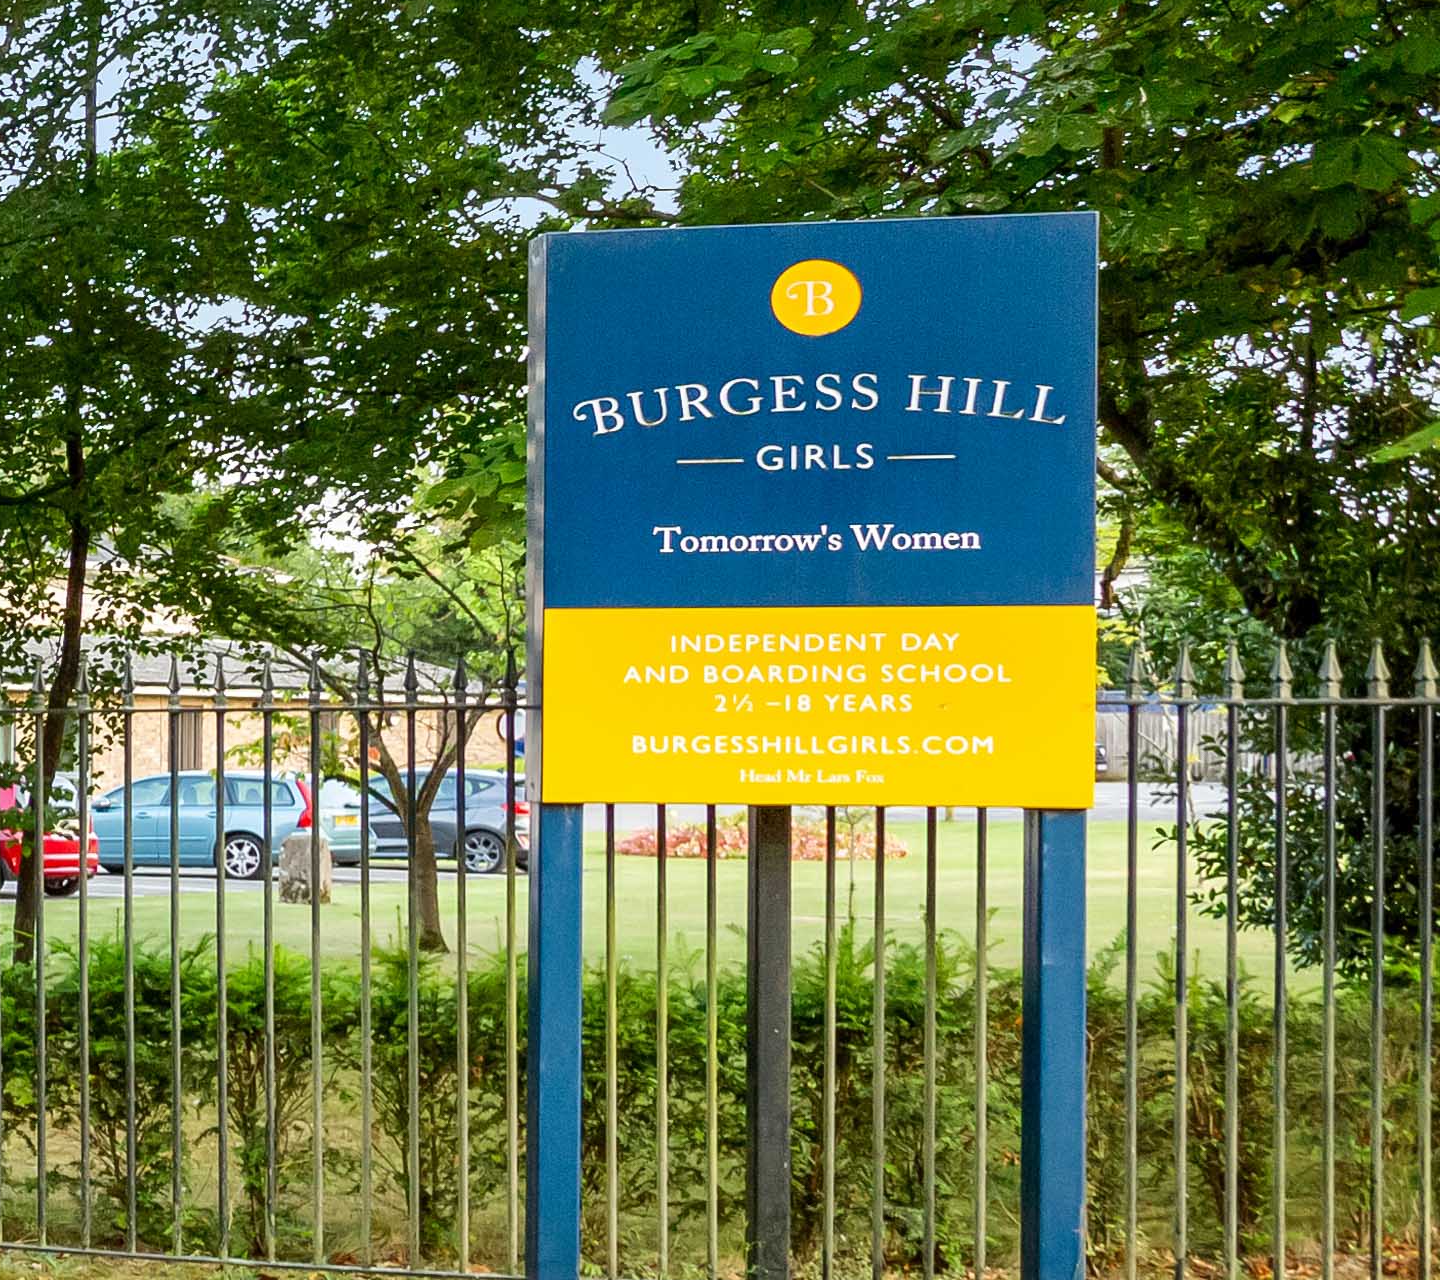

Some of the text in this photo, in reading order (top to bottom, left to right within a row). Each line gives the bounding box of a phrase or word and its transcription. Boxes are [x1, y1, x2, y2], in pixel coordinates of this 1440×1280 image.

[785, 280, 835, 317] B
[571, 372, 1067, 437] BURGESS HILL
[755, 442, 875, 472] GIRLS
[652, 522, 983, 554] Tomorrow's Women
[670, 632, 960, 654] INDEPENDENT DAY
[622, 662, 1012, 685] AND BOARDING SCHOOL
[823, 692, 914, 714] YEARS
[631, 734, 995, 756] BURGESSHILLGIRLS.COM
[739, 768, 782, 784] Head
[787, 768, 811, 784] Mr
[855, 768, 885, 784] Fox
